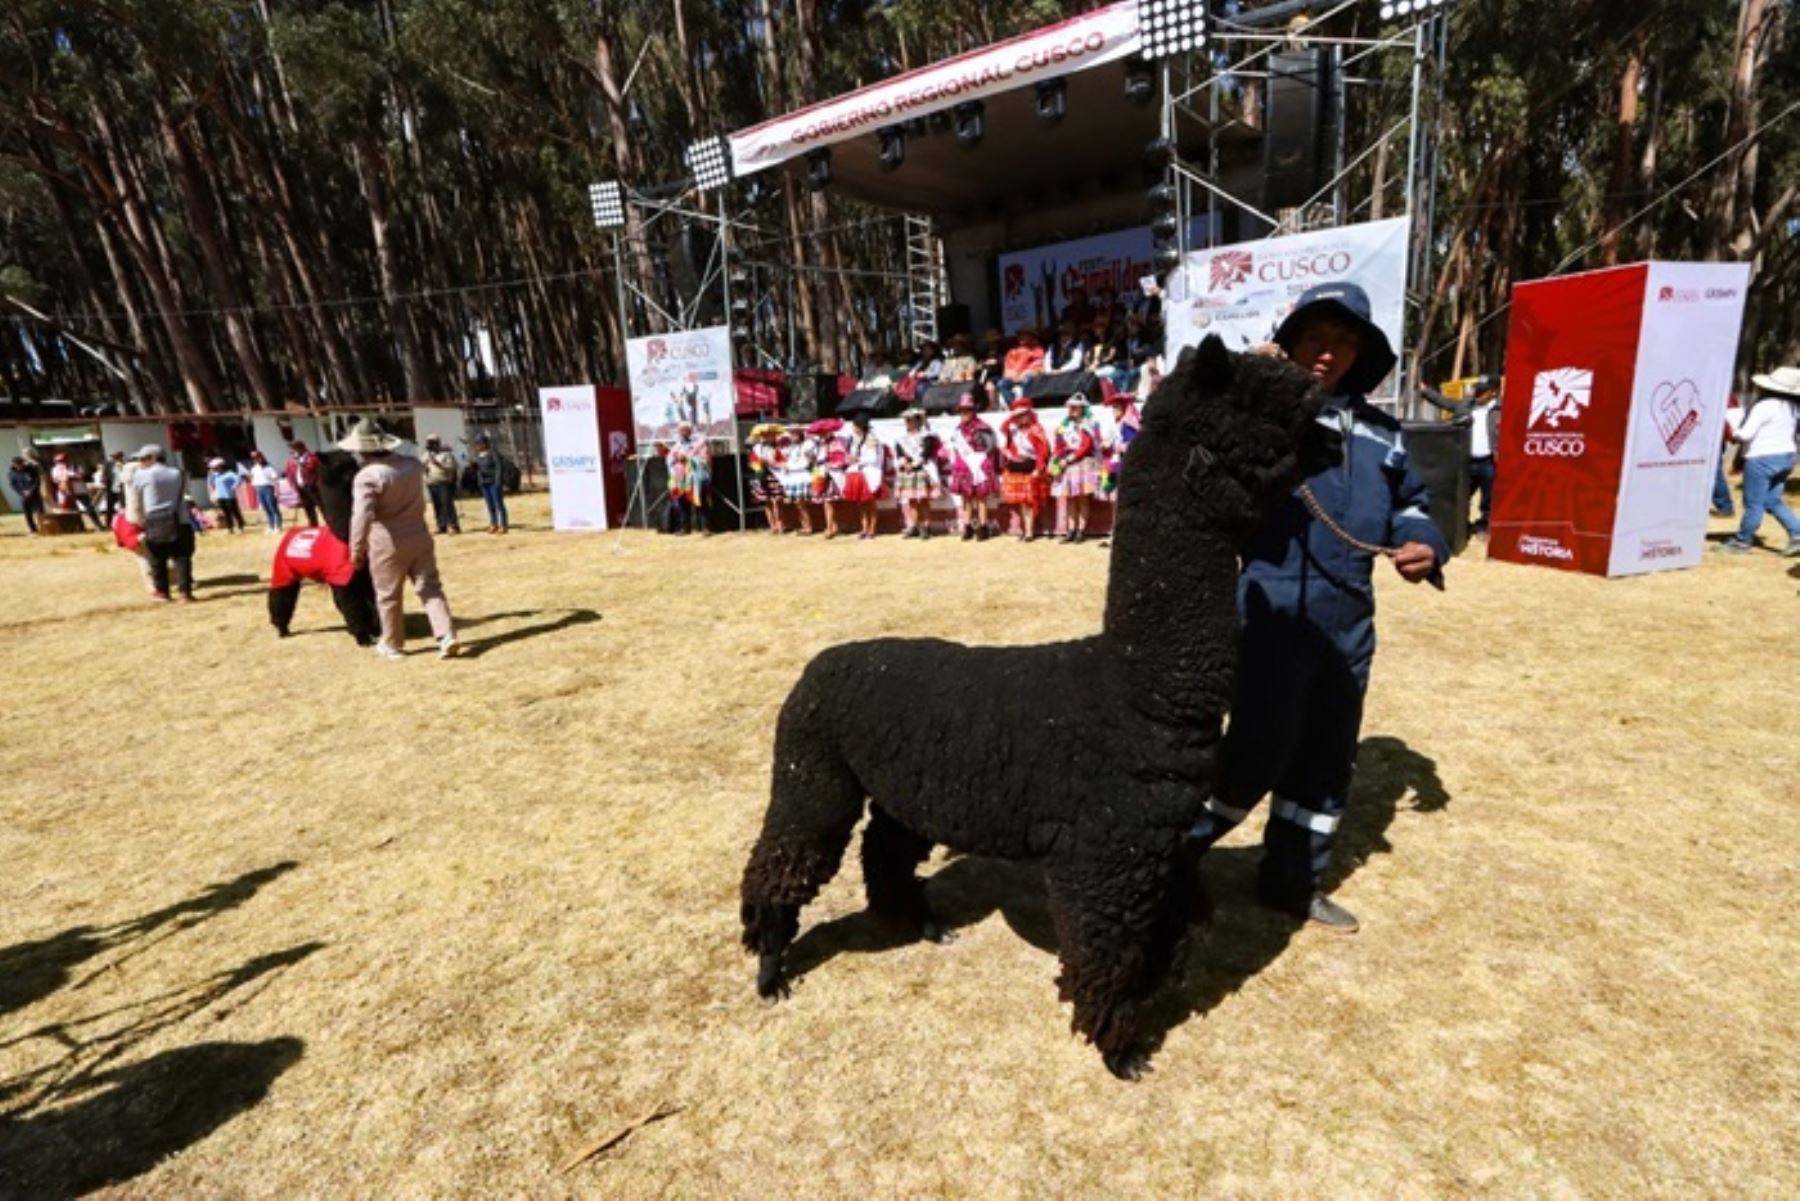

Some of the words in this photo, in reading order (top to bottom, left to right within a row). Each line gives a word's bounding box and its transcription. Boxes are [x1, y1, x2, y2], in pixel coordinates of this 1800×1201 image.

[791, 100, 893, 144] GOBIERNO
[893, 64, 1012, 113] REGIONAL
[1014, 31, 1106, 73] CUSCO
[1258, 250, 1351, 283] CUSCO
[1523, 438, 1585, 457] CUSCO
